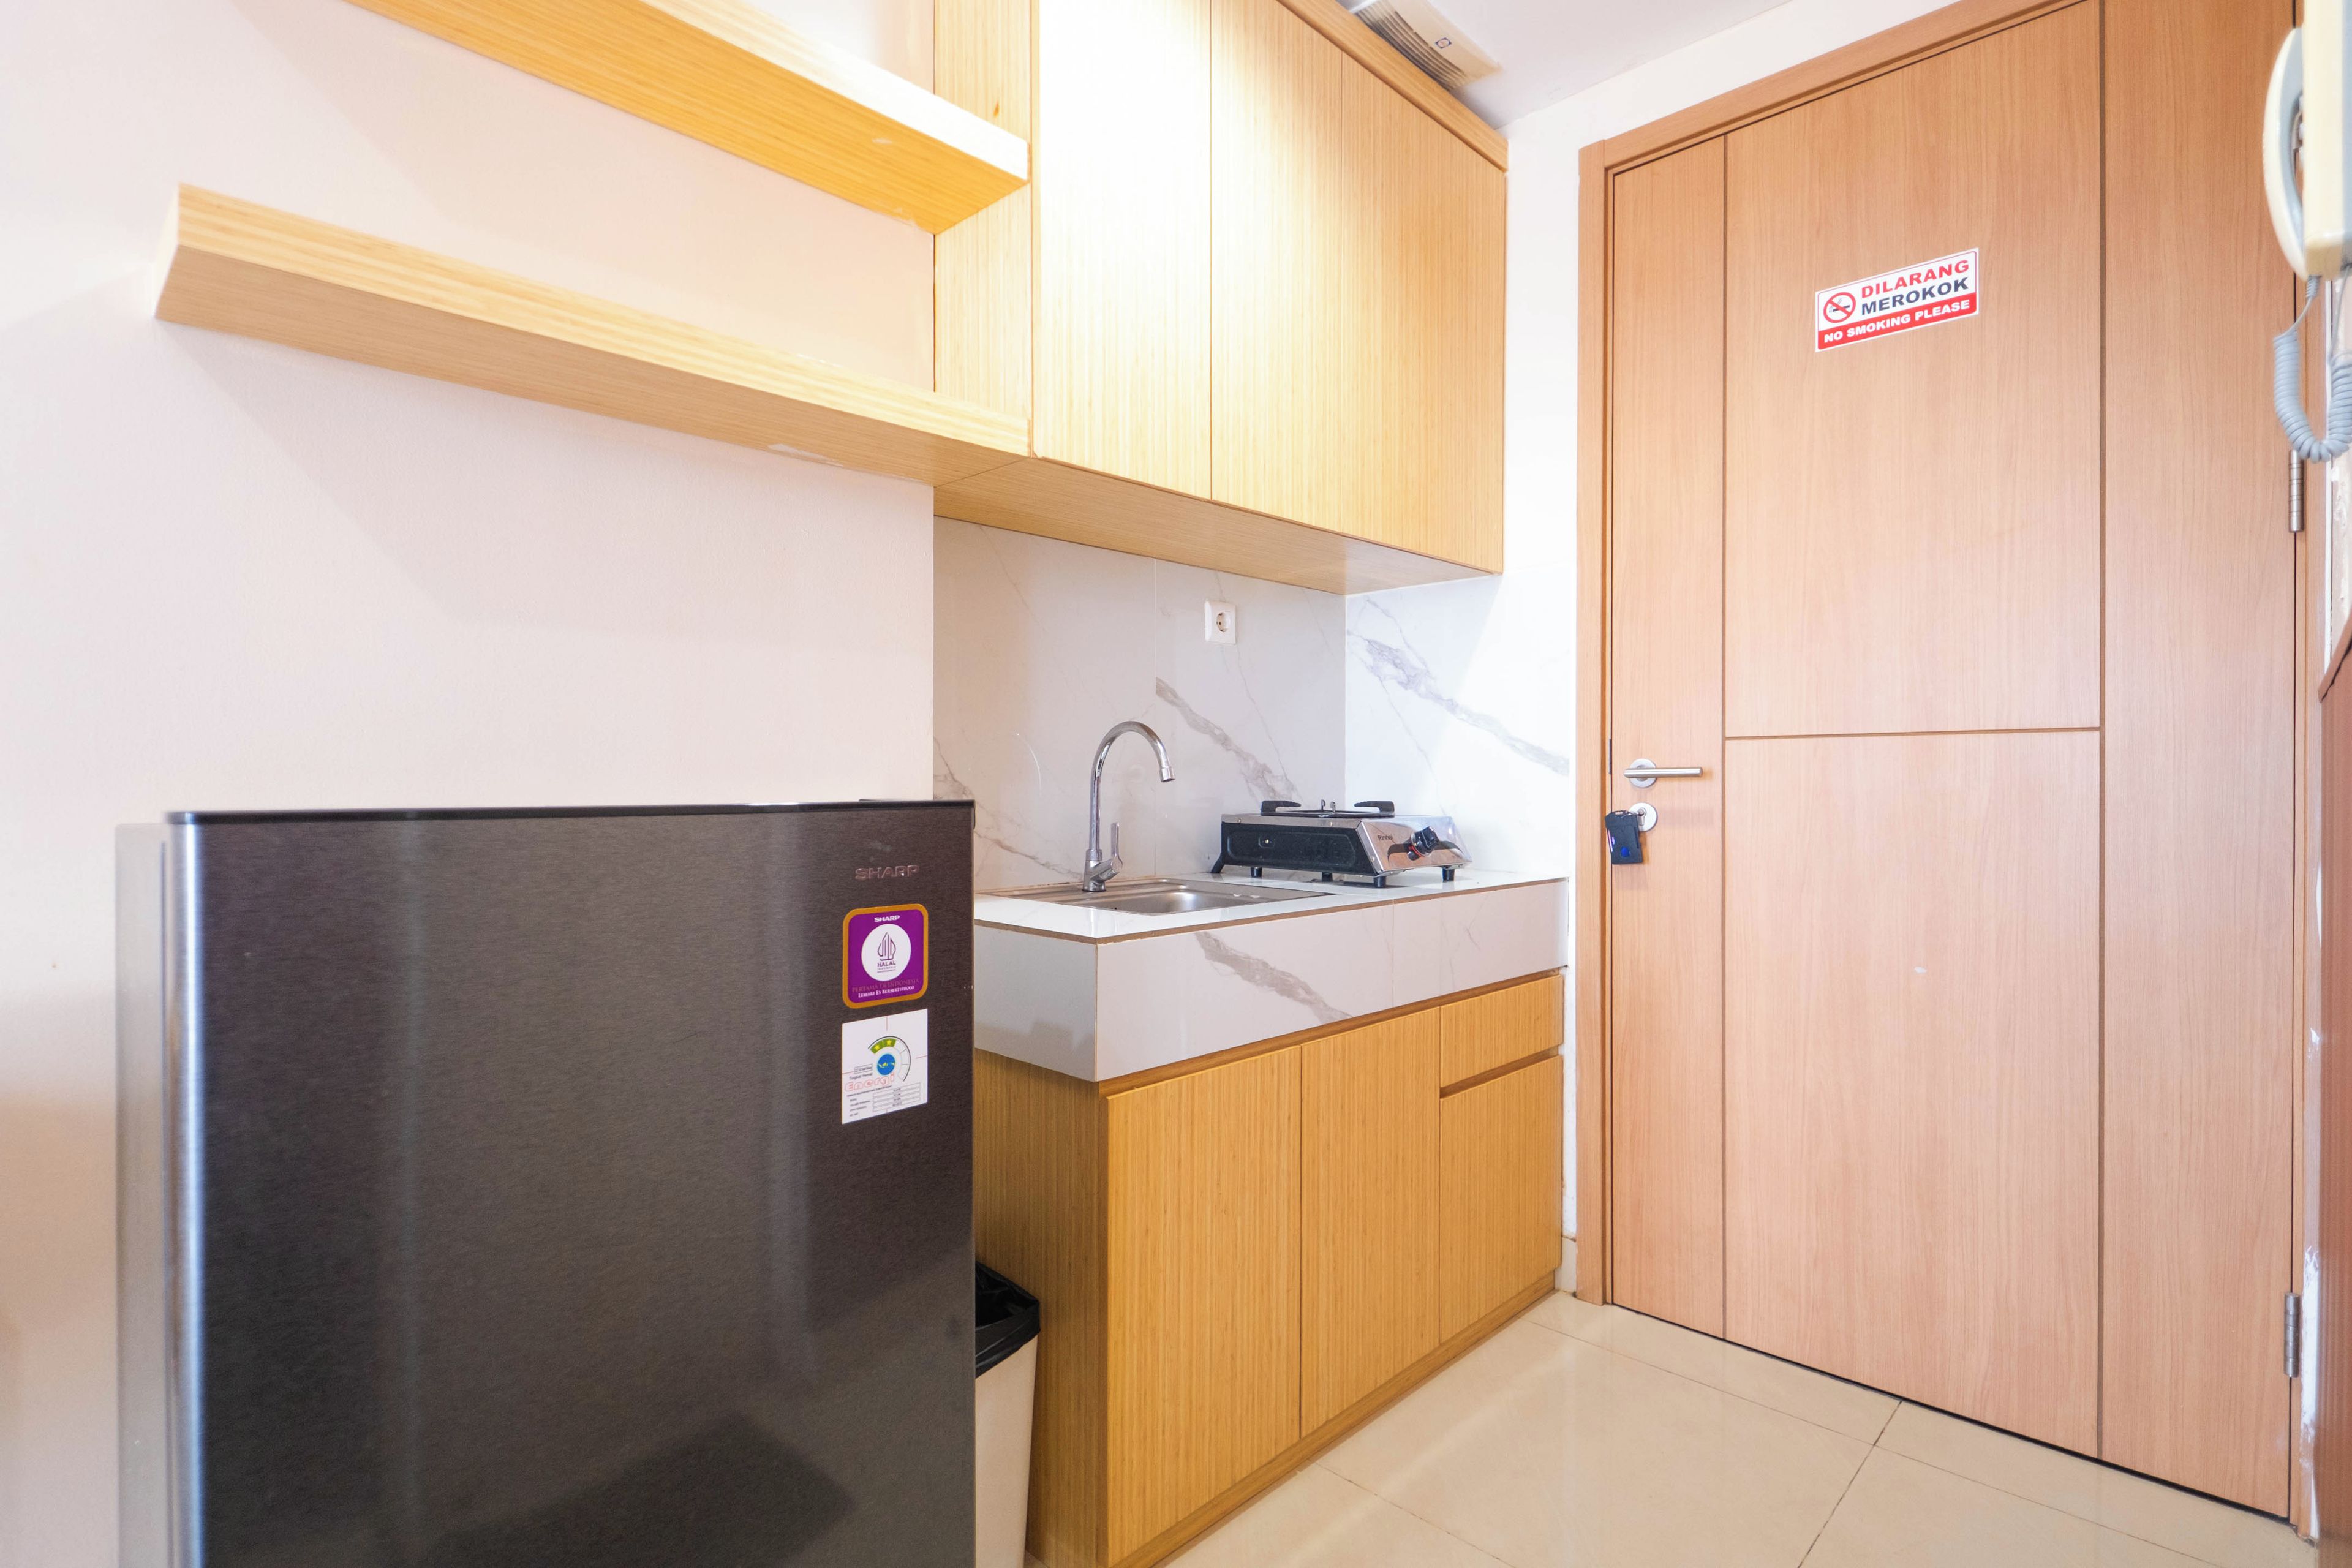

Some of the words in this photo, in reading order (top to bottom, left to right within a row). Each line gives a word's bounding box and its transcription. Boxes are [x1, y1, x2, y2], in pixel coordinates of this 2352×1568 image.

[1861, 259, 1969, 298] DILARANG
[1861, 277, 1969, 316] MEROKOK
[1824, 331, 1843, 343] NO
[1847, 314, 1911, 338] SMOKING
[1915, 300, 1970, 320] PLEASE
[855, 865, 919, 880] SHARP
[852, 984, 878, 993] PERTAMA
[845, 1072, 894, 1091] Energi
